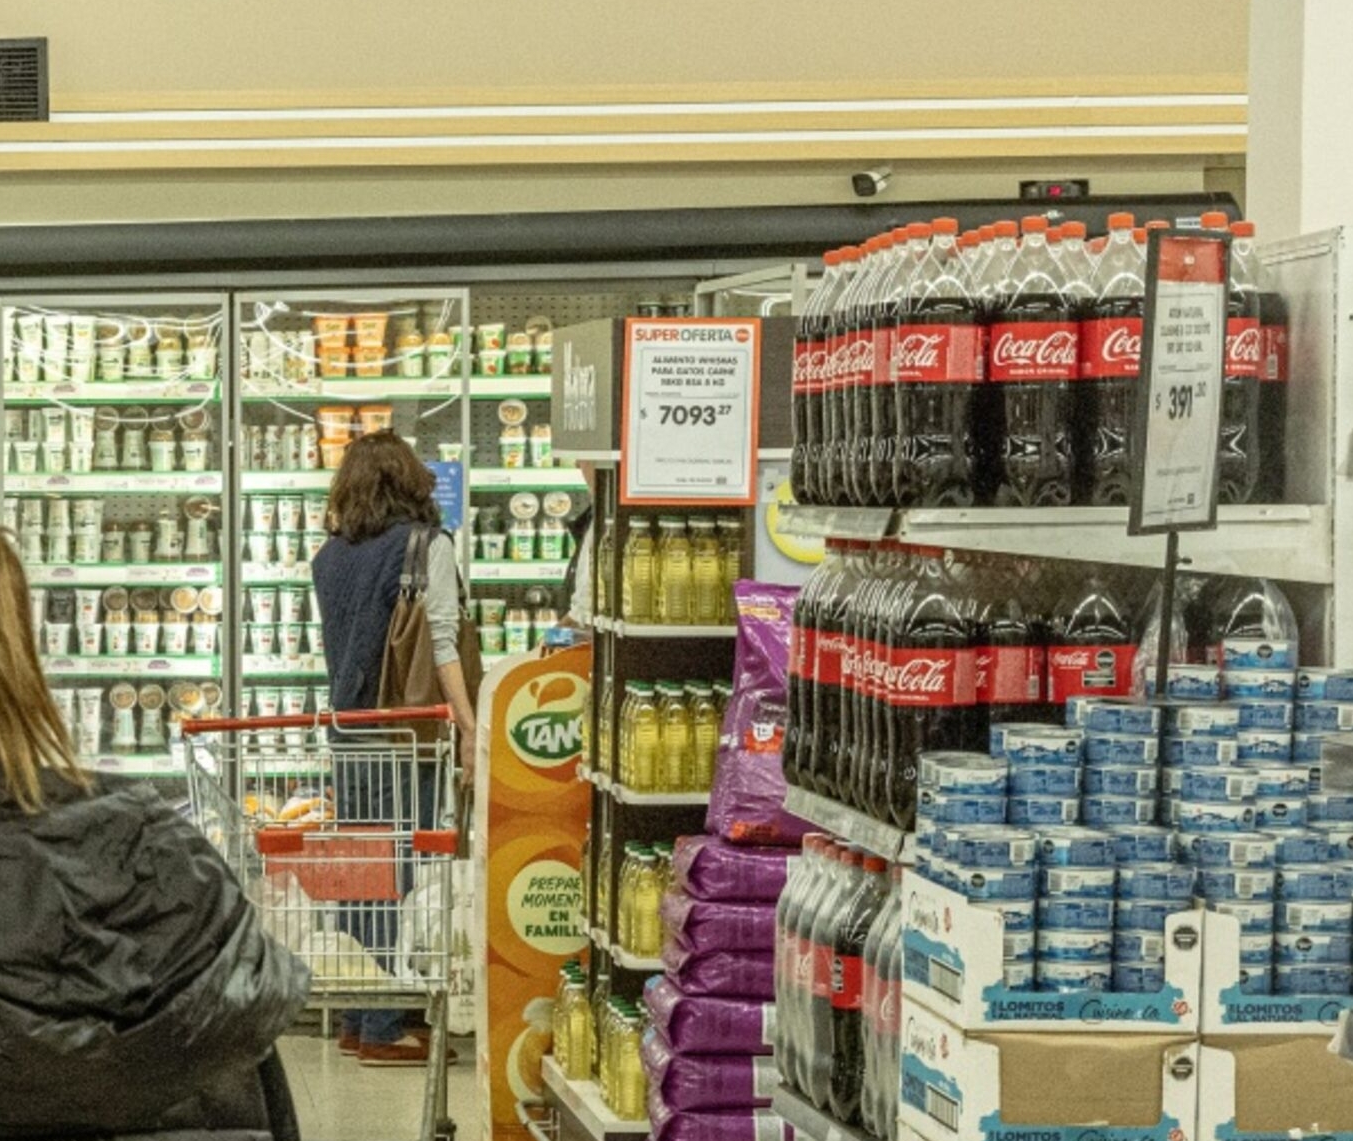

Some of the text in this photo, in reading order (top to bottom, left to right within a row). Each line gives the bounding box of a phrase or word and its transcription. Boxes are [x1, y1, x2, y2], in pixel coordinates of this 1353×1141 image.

[636, 328, 733, 342] SUPEROFERTA
[994, 330, 1078, 366] Coca-Cola
[1168, 385, 1193, 420] 391
[659, 404, 717, 426] 7093
[718, 405, 732, 416] 27
[549, 910, 570, 922] EN
[998, 1001, 1065, 1013] LOMITOS
[1235, 1003, 1304, 1015] LOMITOS
